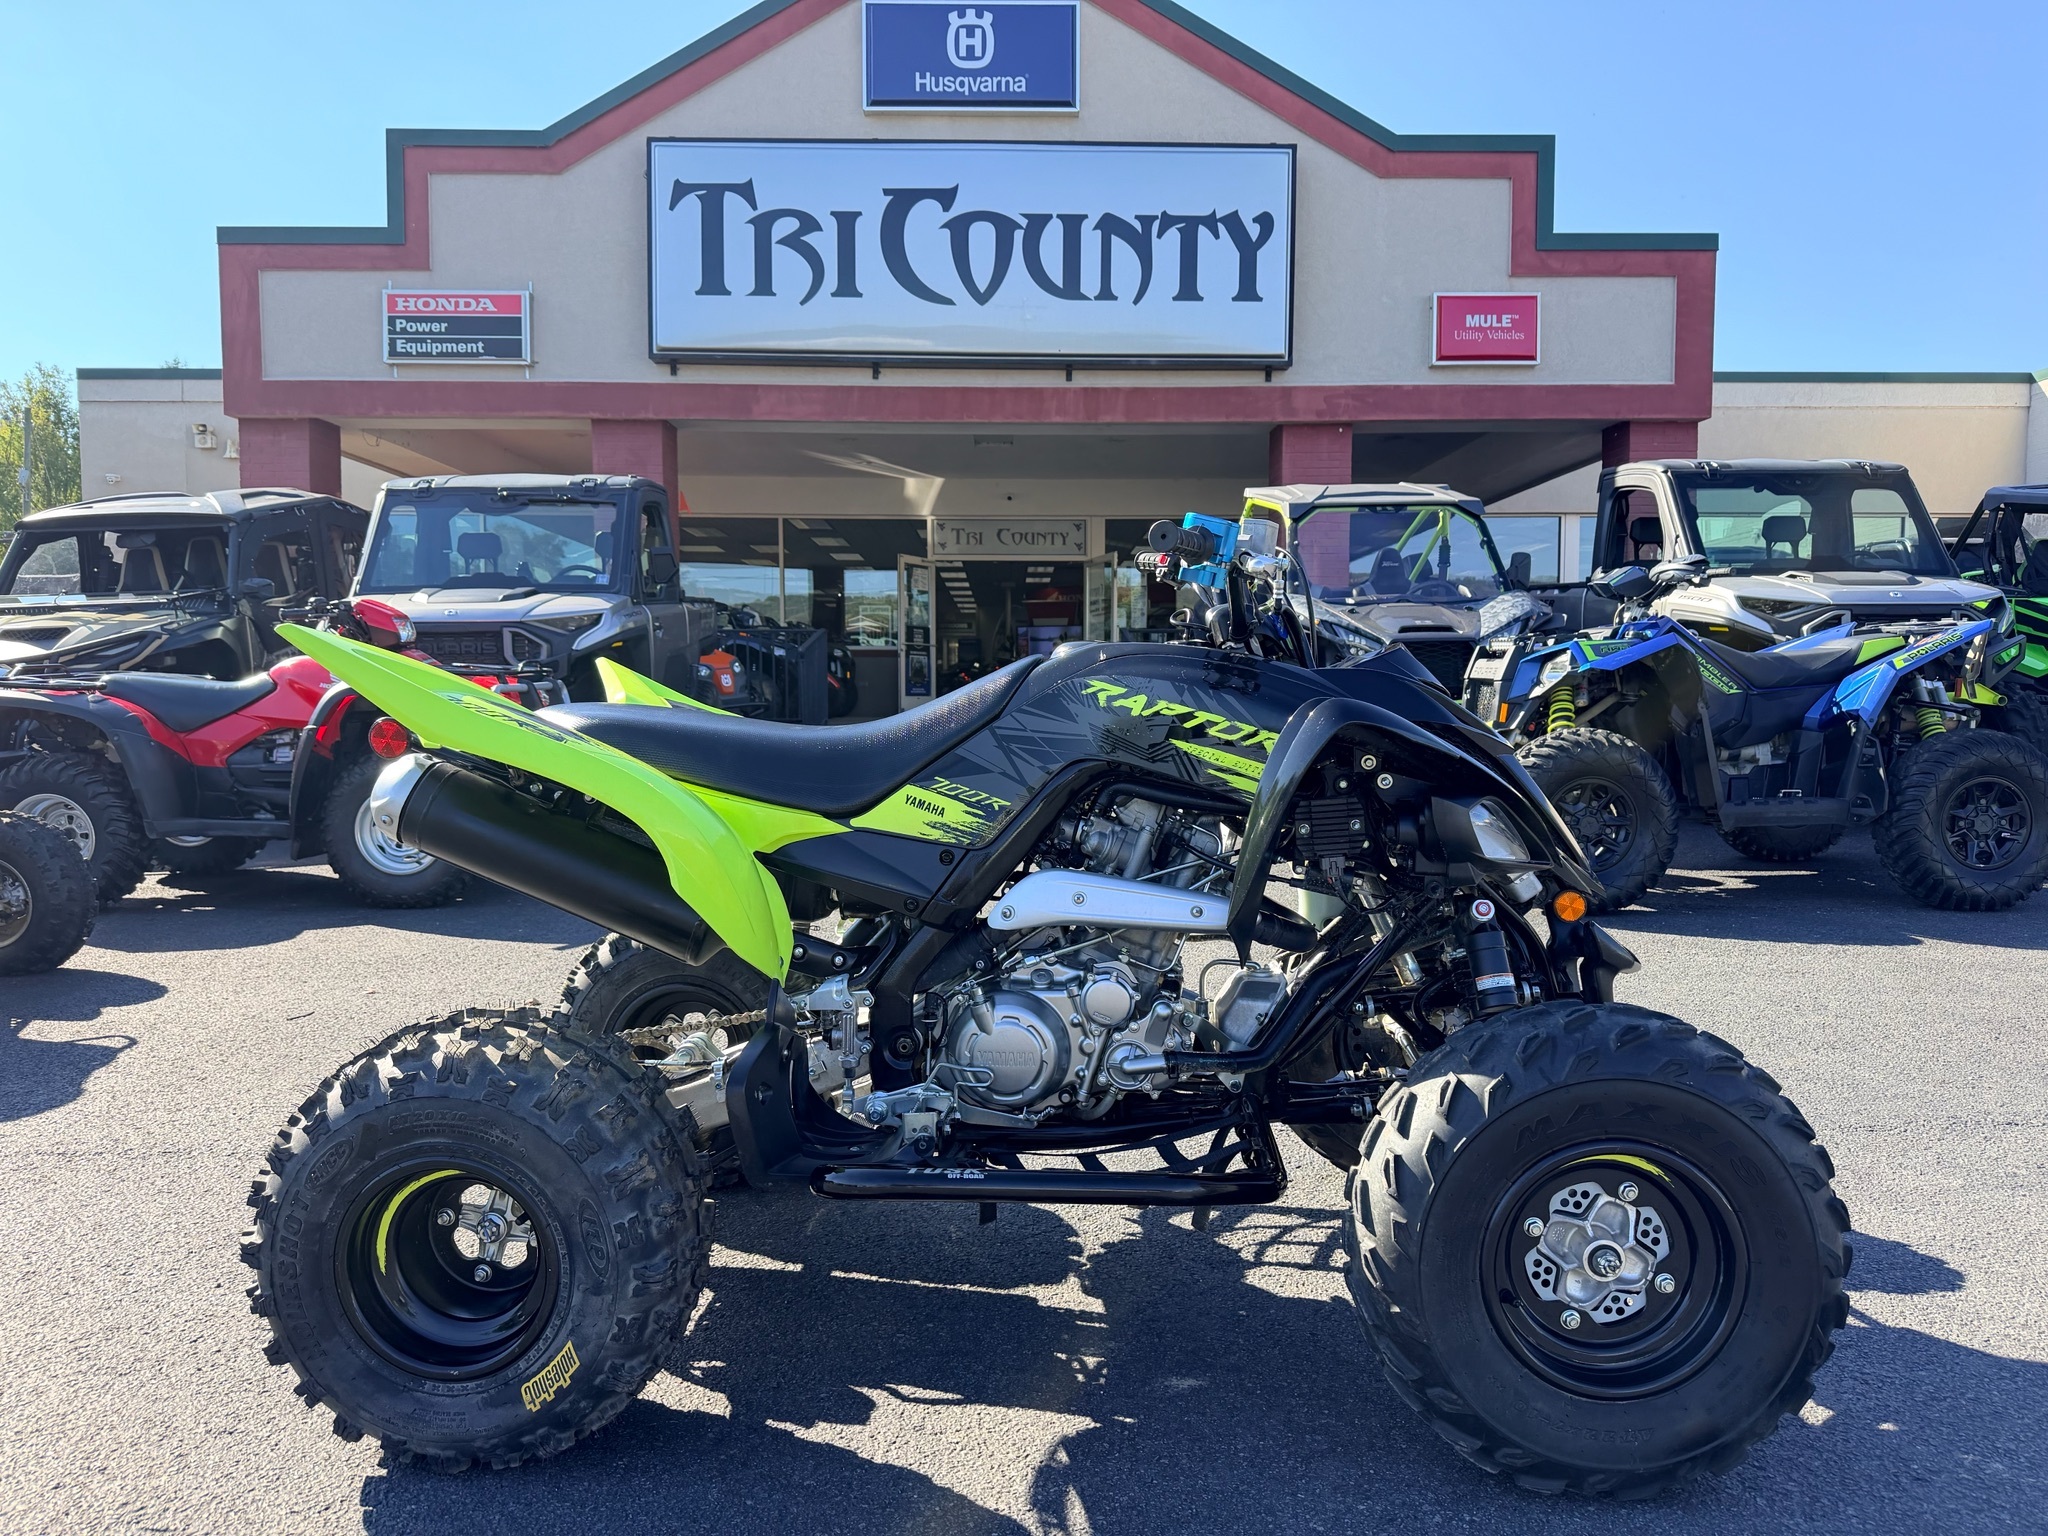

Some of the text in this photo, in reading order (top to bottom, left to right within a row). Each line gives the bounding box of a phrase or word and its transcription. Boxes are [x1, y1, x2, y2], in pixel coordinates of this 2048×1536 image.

[915, 72, 1026, 95] Husqvarna
[395, 297, 498, 312] HONDA
[395, 318, 449, 332] Power
[1454, 330, 1526, 342] Utility Vehicles
[395, 339, 485, 355] Equipment
[416, 641, 498, 655] OLARIS
[1907, 632, 1964, 661] POLARIS
[904, 793, 946, 818] YAMAHA
[977, 1050, 1036, 1068] YAMAHA
